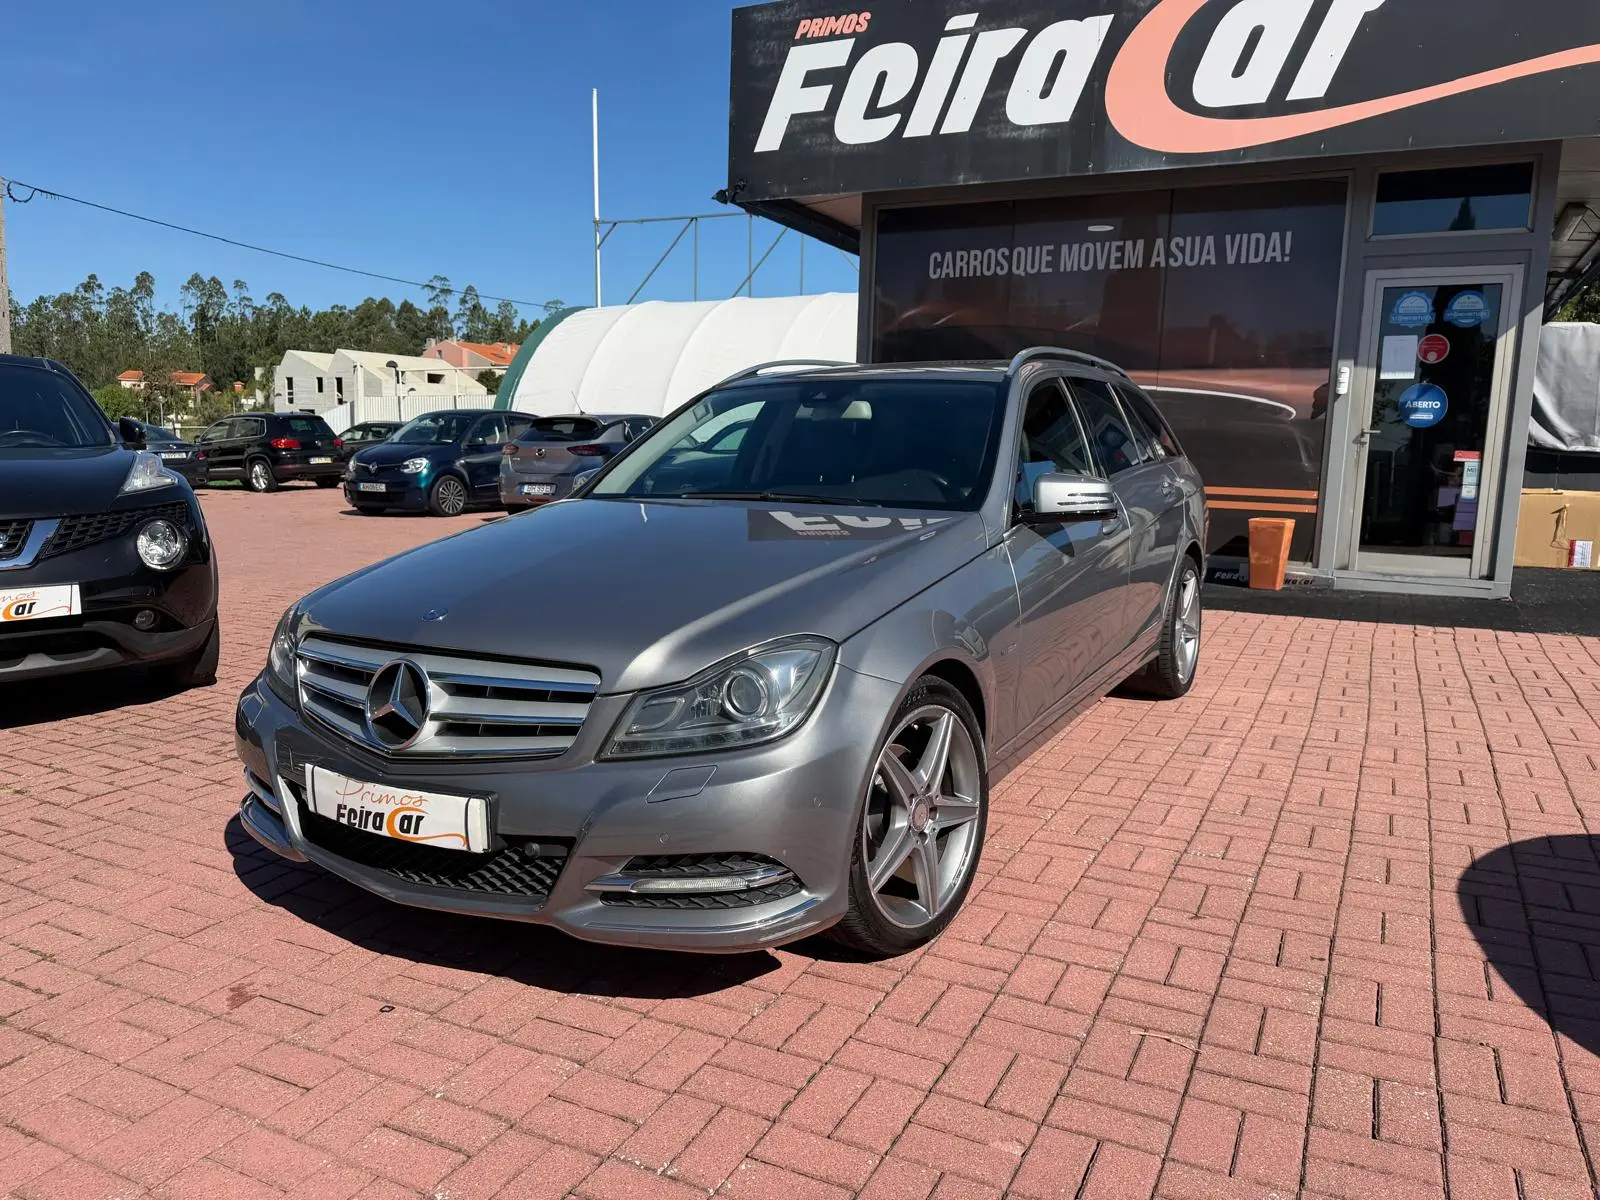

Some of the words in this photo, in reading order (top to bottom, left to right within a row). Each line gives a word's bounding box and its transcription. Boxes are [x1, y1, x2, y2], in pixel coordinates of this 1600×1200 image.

[794, 12, 872, 40] PRIMOS
[929, 248, 1008, 280] CARROS
[1012, 245, 1054, 277] QUE
[1059, 239, 1145, 273] MOVEM
[1150, 238, 1167, 268] A
[1169, 235, 1216, 268] SUA
[1225, 231, 1293, 265] VIDA!
[1405, 400, 1441, 409] ABERTO
[336, 777, 429, 809] Primos
